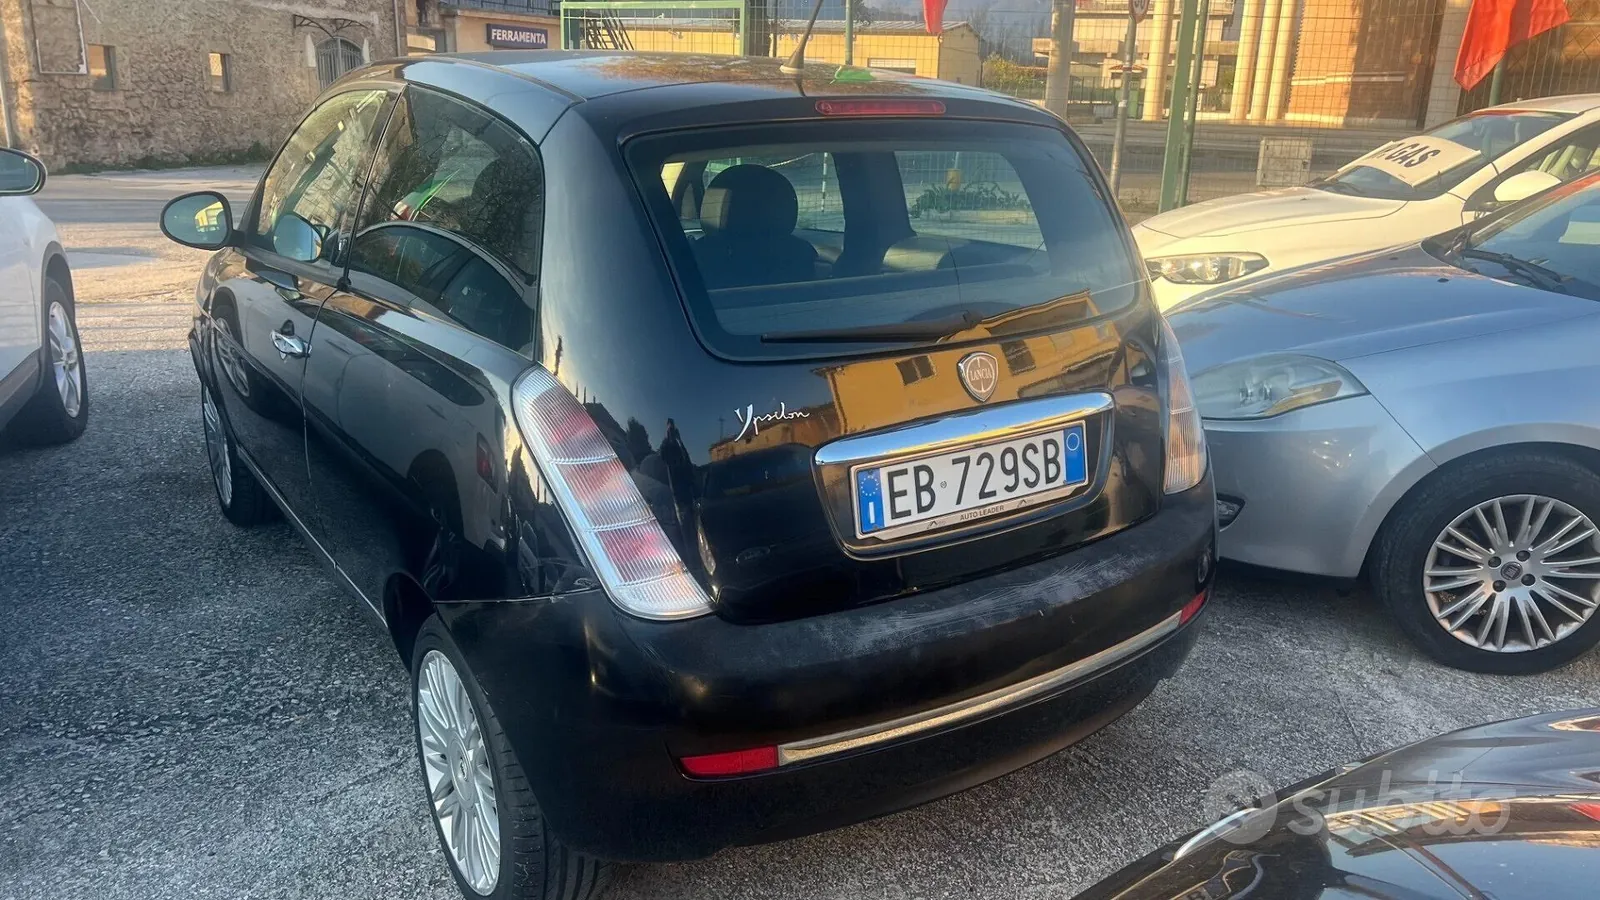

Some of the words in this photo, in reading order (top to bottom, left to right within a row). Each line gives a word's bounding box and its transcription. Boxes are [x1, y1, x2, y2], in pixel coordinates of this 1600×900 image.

[491, 28, 547, 44] FERRAMENTA
[1384, 143, 1441, 168] GAS
[970, 368, 993, 381] LANCIA
[734, 402, 810, 442] Ypsilon
[887, 464, 936, 520] EB
[951, 438, 1061, 505] 729SB
[960, 511, 979, 521] AUTO
[979, 505, 1005, 516] LEADER
